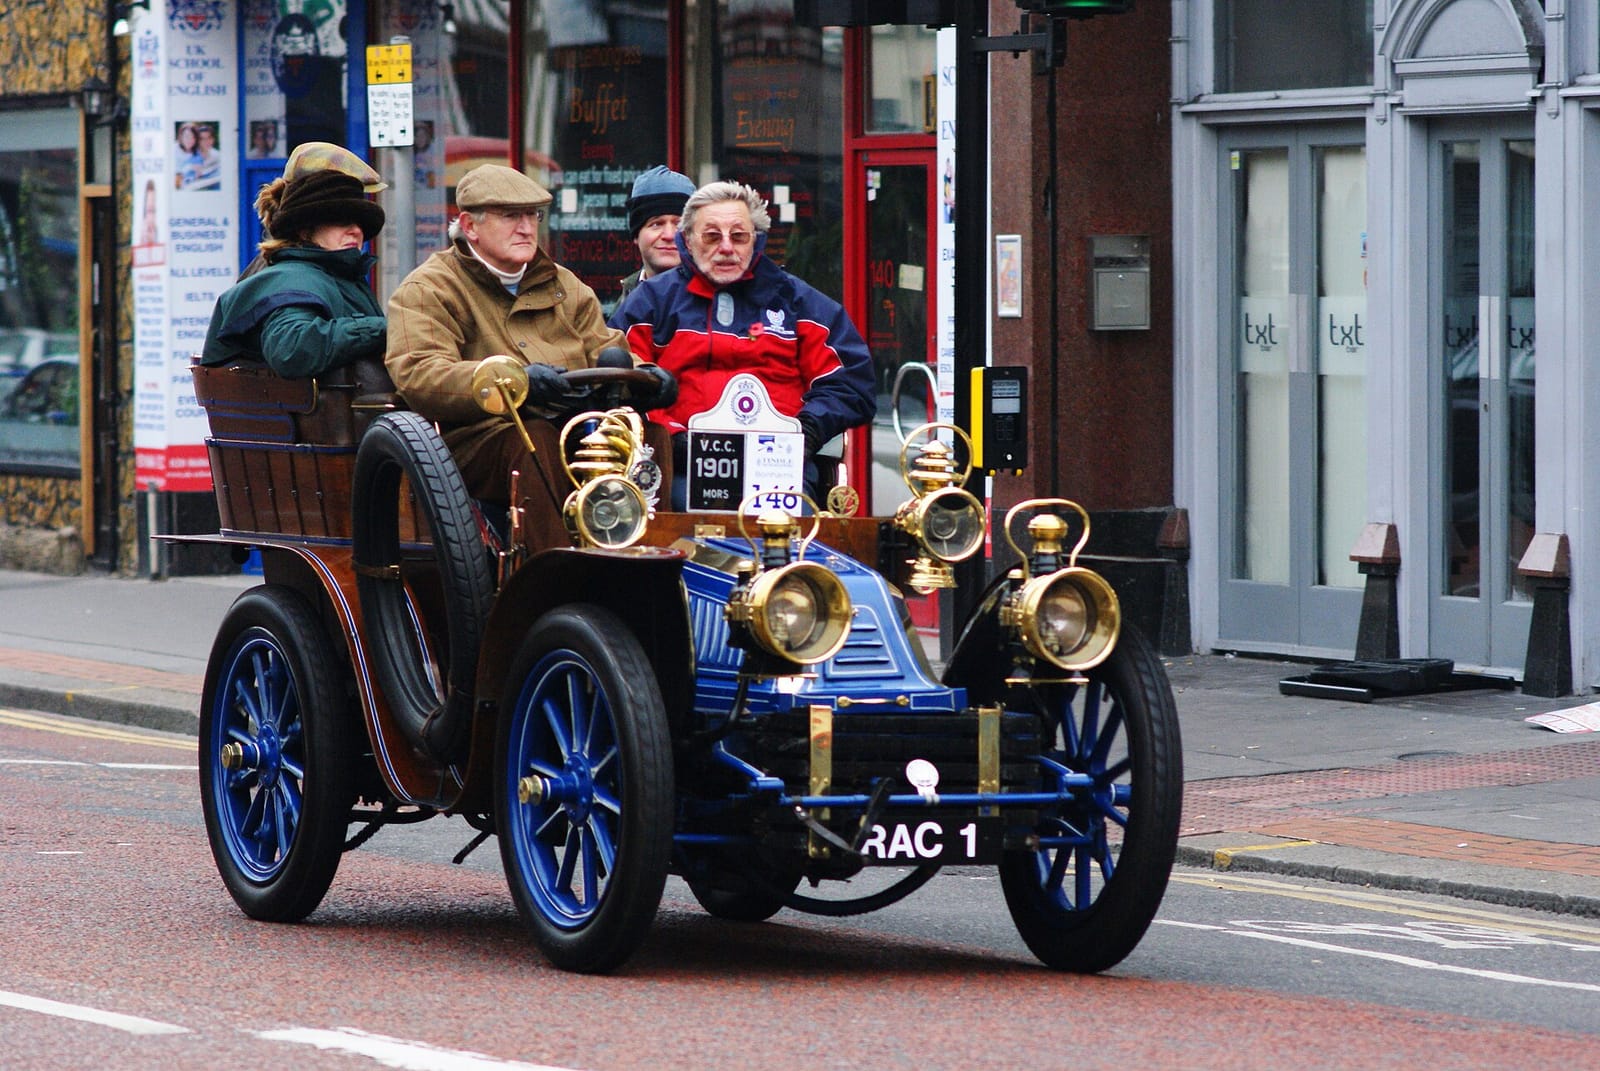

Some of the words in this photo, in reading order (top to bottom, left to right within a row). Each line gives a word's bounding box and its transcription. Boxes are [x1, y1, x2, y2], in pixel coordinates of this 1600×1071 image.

[185, 44, 206, 56] UK
[168, 58, 224, 69] SCHOOL
[187, 72, 204, 81] OF
[168, 85, 227, 96] ENGLISH
[569, 82, 628, 135] Buffet
[736, 109, 795, 152] Evening
[169, 217, 217, 227] GENERAL
[170, 230, 226, 240] BUSINESS
[175, 243, 223, 253] ENGLISH
[561, 232, 603, 262] Service
[170, 267, 188, 277] ALL
[192, 267, 231, 277] LEVELS
[869, 260, 895, 288] 140
[185, 292, 215, 302] IELTS
[1245, 312, 1278, 345] txt
[1329, 313, 1364, 346] txt
[1508, 314, 1534, 349] tx
[700, 439, 735, 452] V.C.C.
[695, 457, 738, 478] 1901
[703, 489, 729, 499] MORS
[752, 484, 798, 509] 146
[861, 821, 944, 859] RAC
[959, 822, 977, 858] 1
